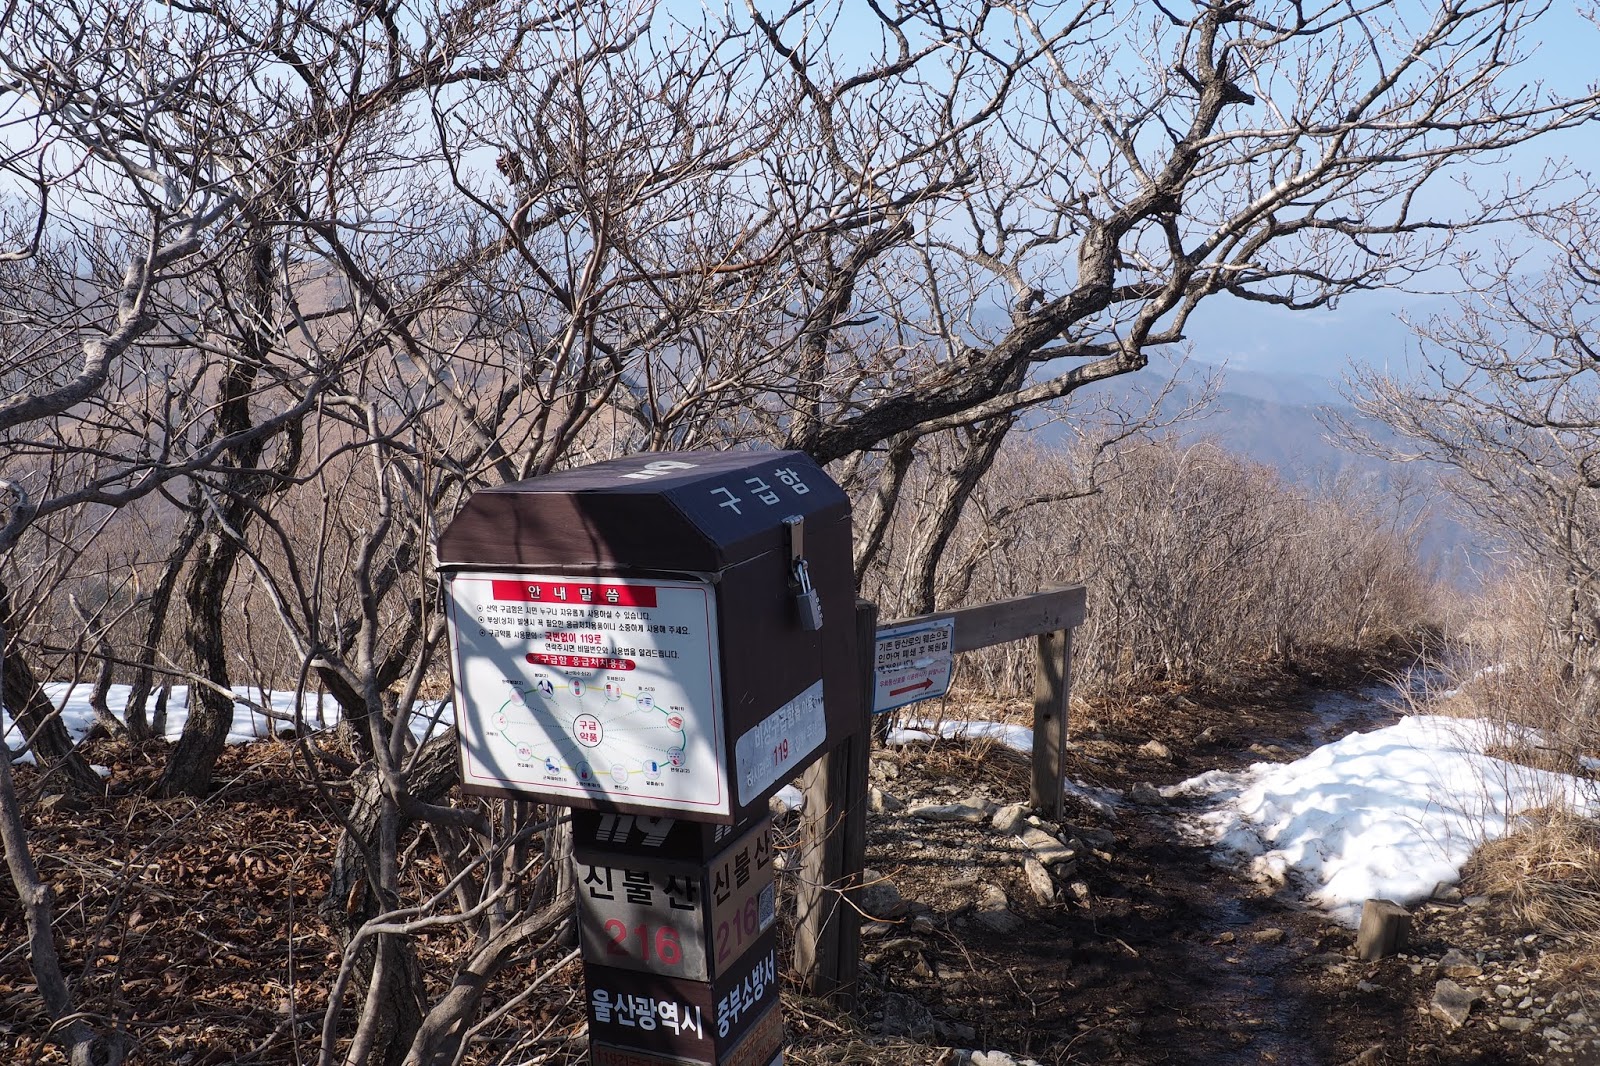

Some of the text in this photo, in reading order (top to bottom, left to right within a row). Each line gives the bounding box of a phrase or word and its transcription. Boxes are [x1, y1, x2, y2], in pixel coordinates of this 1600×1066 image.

[500, 605, 523, 614] 구급함은
[525, 606, 538, 615] 시민
[540, 607, 557, 615] 누구나
[560, 608, 585, 618] 자유롭게
[587, 609, 612, 619] 사용하실
[615, 611, 621, 619] 수
[623, 611, 652, 621] 있습니다.
[646, 624, 666, 634] 사용해
[545, 631, 577, 643] 국번없이
[580, 633, 602, 645] 119로
[879, 641, 893, 651] 기존
[895, 635, 921, 650] 등산로의
[611, 647, 637, 656] 사용법을
[638, 648, 680, 659] 알려드립니다.
[878, 652, 900, 664] 인하여
[919, 646, 925, 654] 후
[572, 656, 627, 670] 응급처치용품
[579, 720, 597, 731] 구급
[579, 732, 598, 742] 약품
[716, 895, 757, 963] 216
[603, 918, 683, 965] 216
[717, 948, 775, 1038] 중부소방서
[591, 988, 703, 1040] 울산광역시
